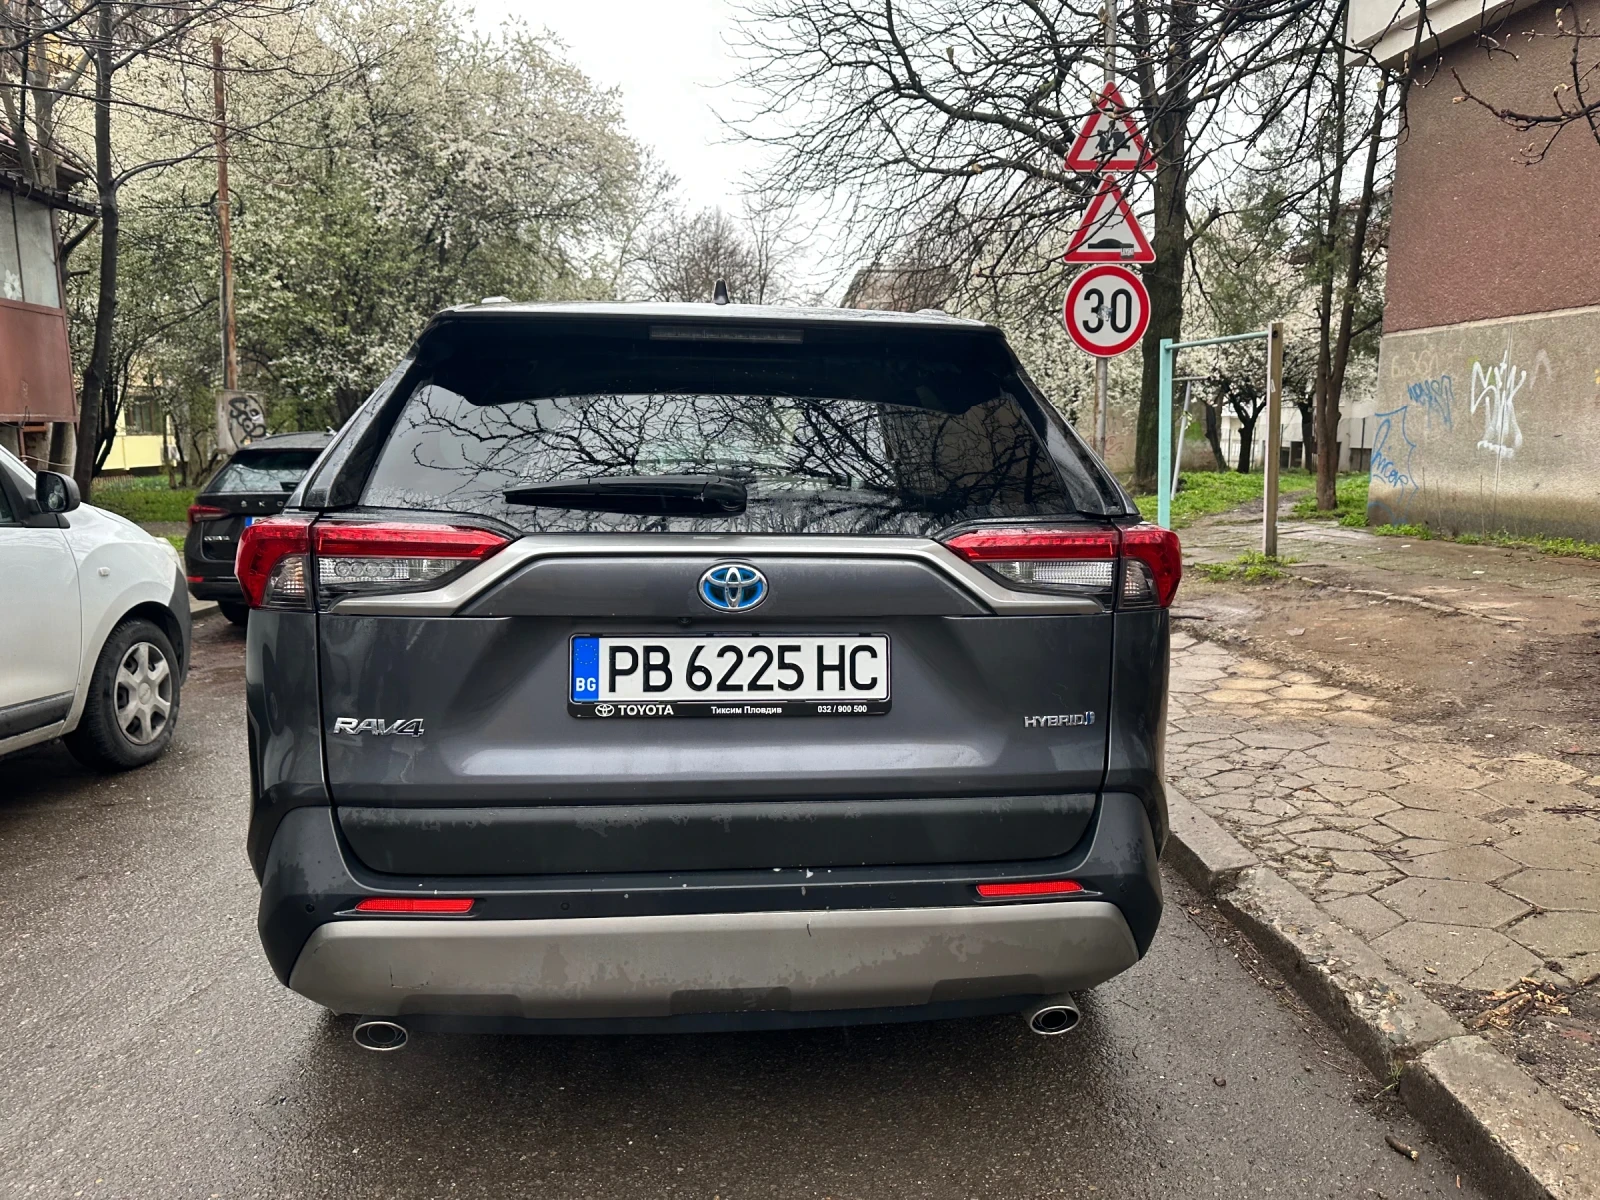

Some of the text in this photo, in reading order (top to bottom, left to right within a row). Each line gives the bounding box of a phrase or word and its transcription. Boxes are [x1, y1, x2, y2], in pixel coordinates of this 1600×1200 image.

[1083, 288, 1132, 333] 30
[608, 644, 878, 693] PB 6225 HC
[576, 677, 597, 692] BG
[617, 704, 675, 716] TOYOTA
[710, 705, 783, 715] Тиксим Пловдив
[817, 704, 868, 713] 032 / 900 500
[333, 717, 425, 738] RAV4
[1024, 714, 1084, 728] HYBRID
